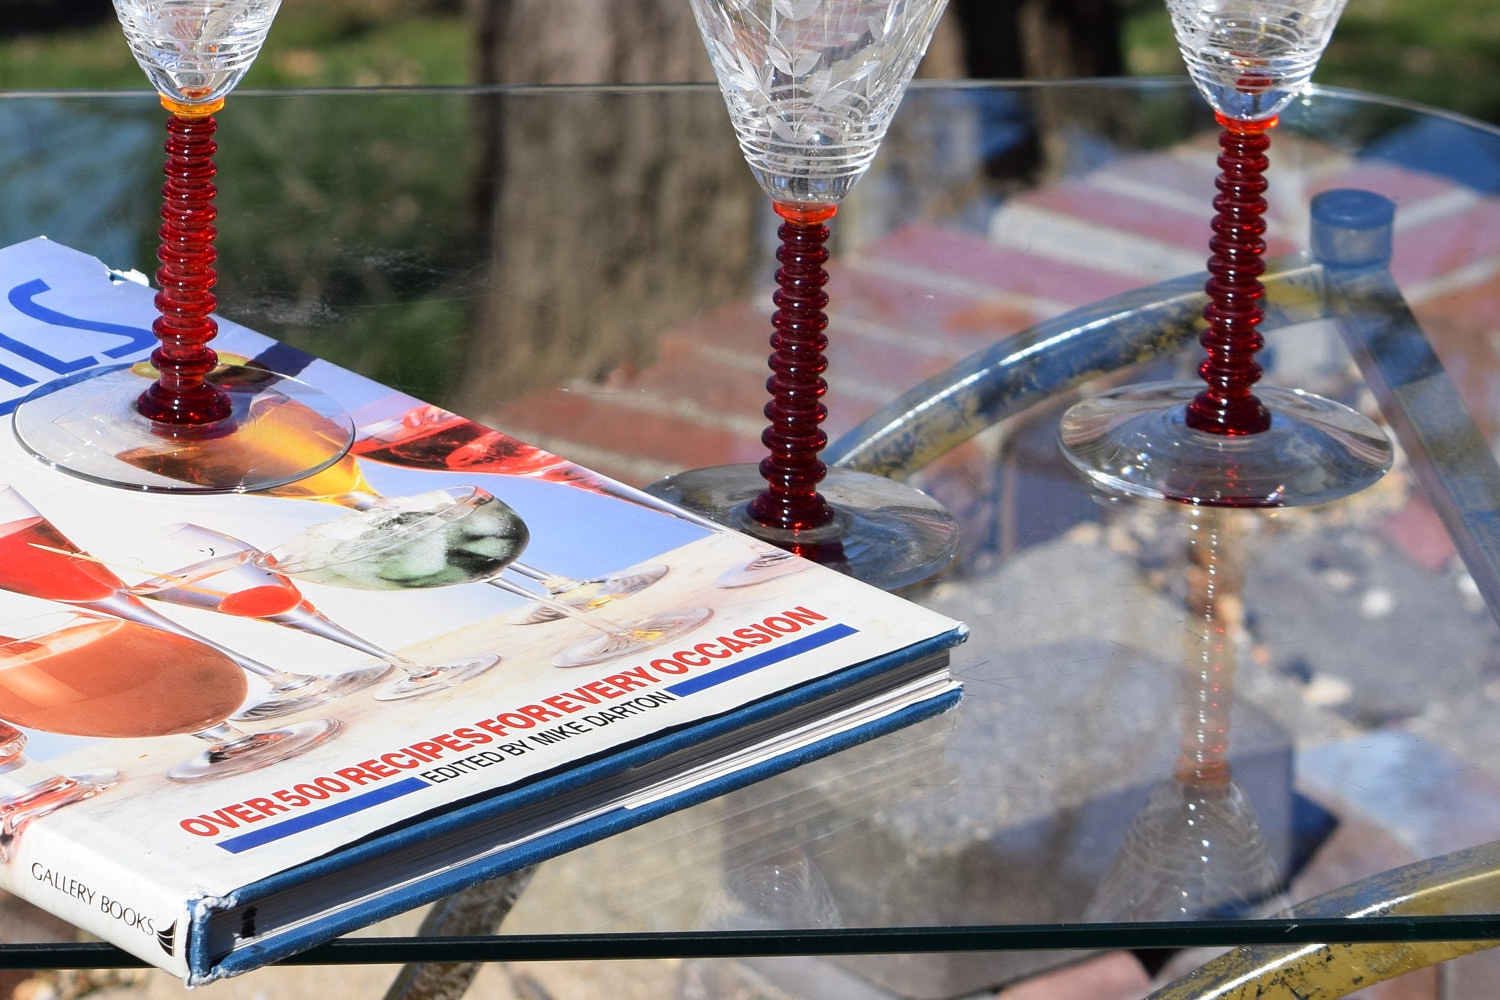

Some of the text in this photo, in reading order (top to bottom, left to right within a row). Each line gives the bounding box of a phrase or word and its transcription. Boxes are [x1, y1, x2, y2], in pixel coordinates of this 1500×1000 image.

[179, 606, 829, 837] OVER 500 RECIPES FOR EVERY OCCASION
[419, 691, 677, 784] EDITED BY MIKE DARTON
[31, 862, 155, 936] GALLERY BOOKS
